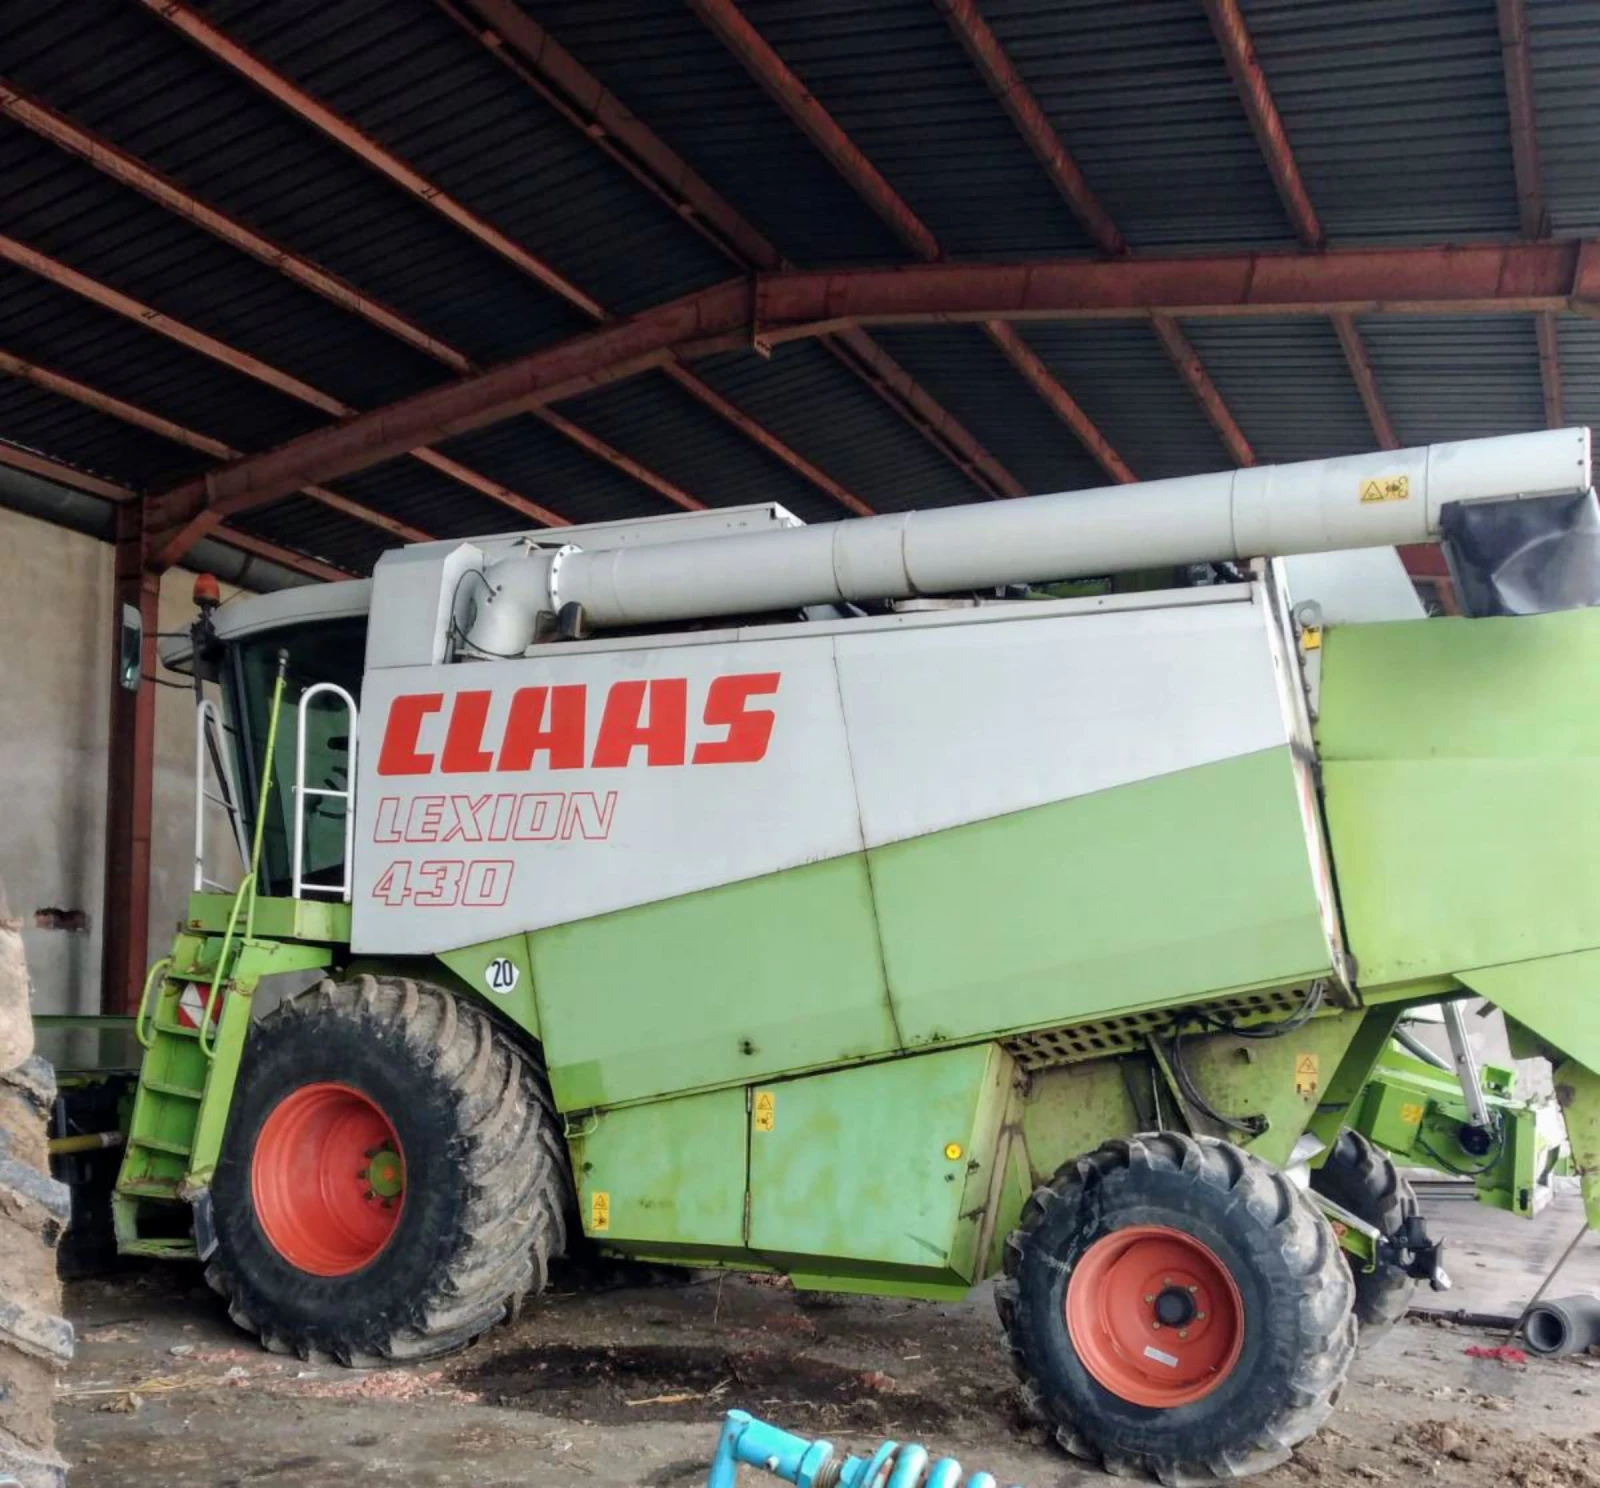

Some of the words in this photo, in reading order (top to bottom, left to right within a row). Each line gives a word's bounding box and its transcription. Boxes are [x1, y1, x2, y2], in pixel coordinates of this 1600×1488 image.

[378, 672, 781, 776] CLAAS
[374, 790, 618, 844] LEXION
[373, 860, 514, 908] 430
[492, 960, 514, 988] 20
